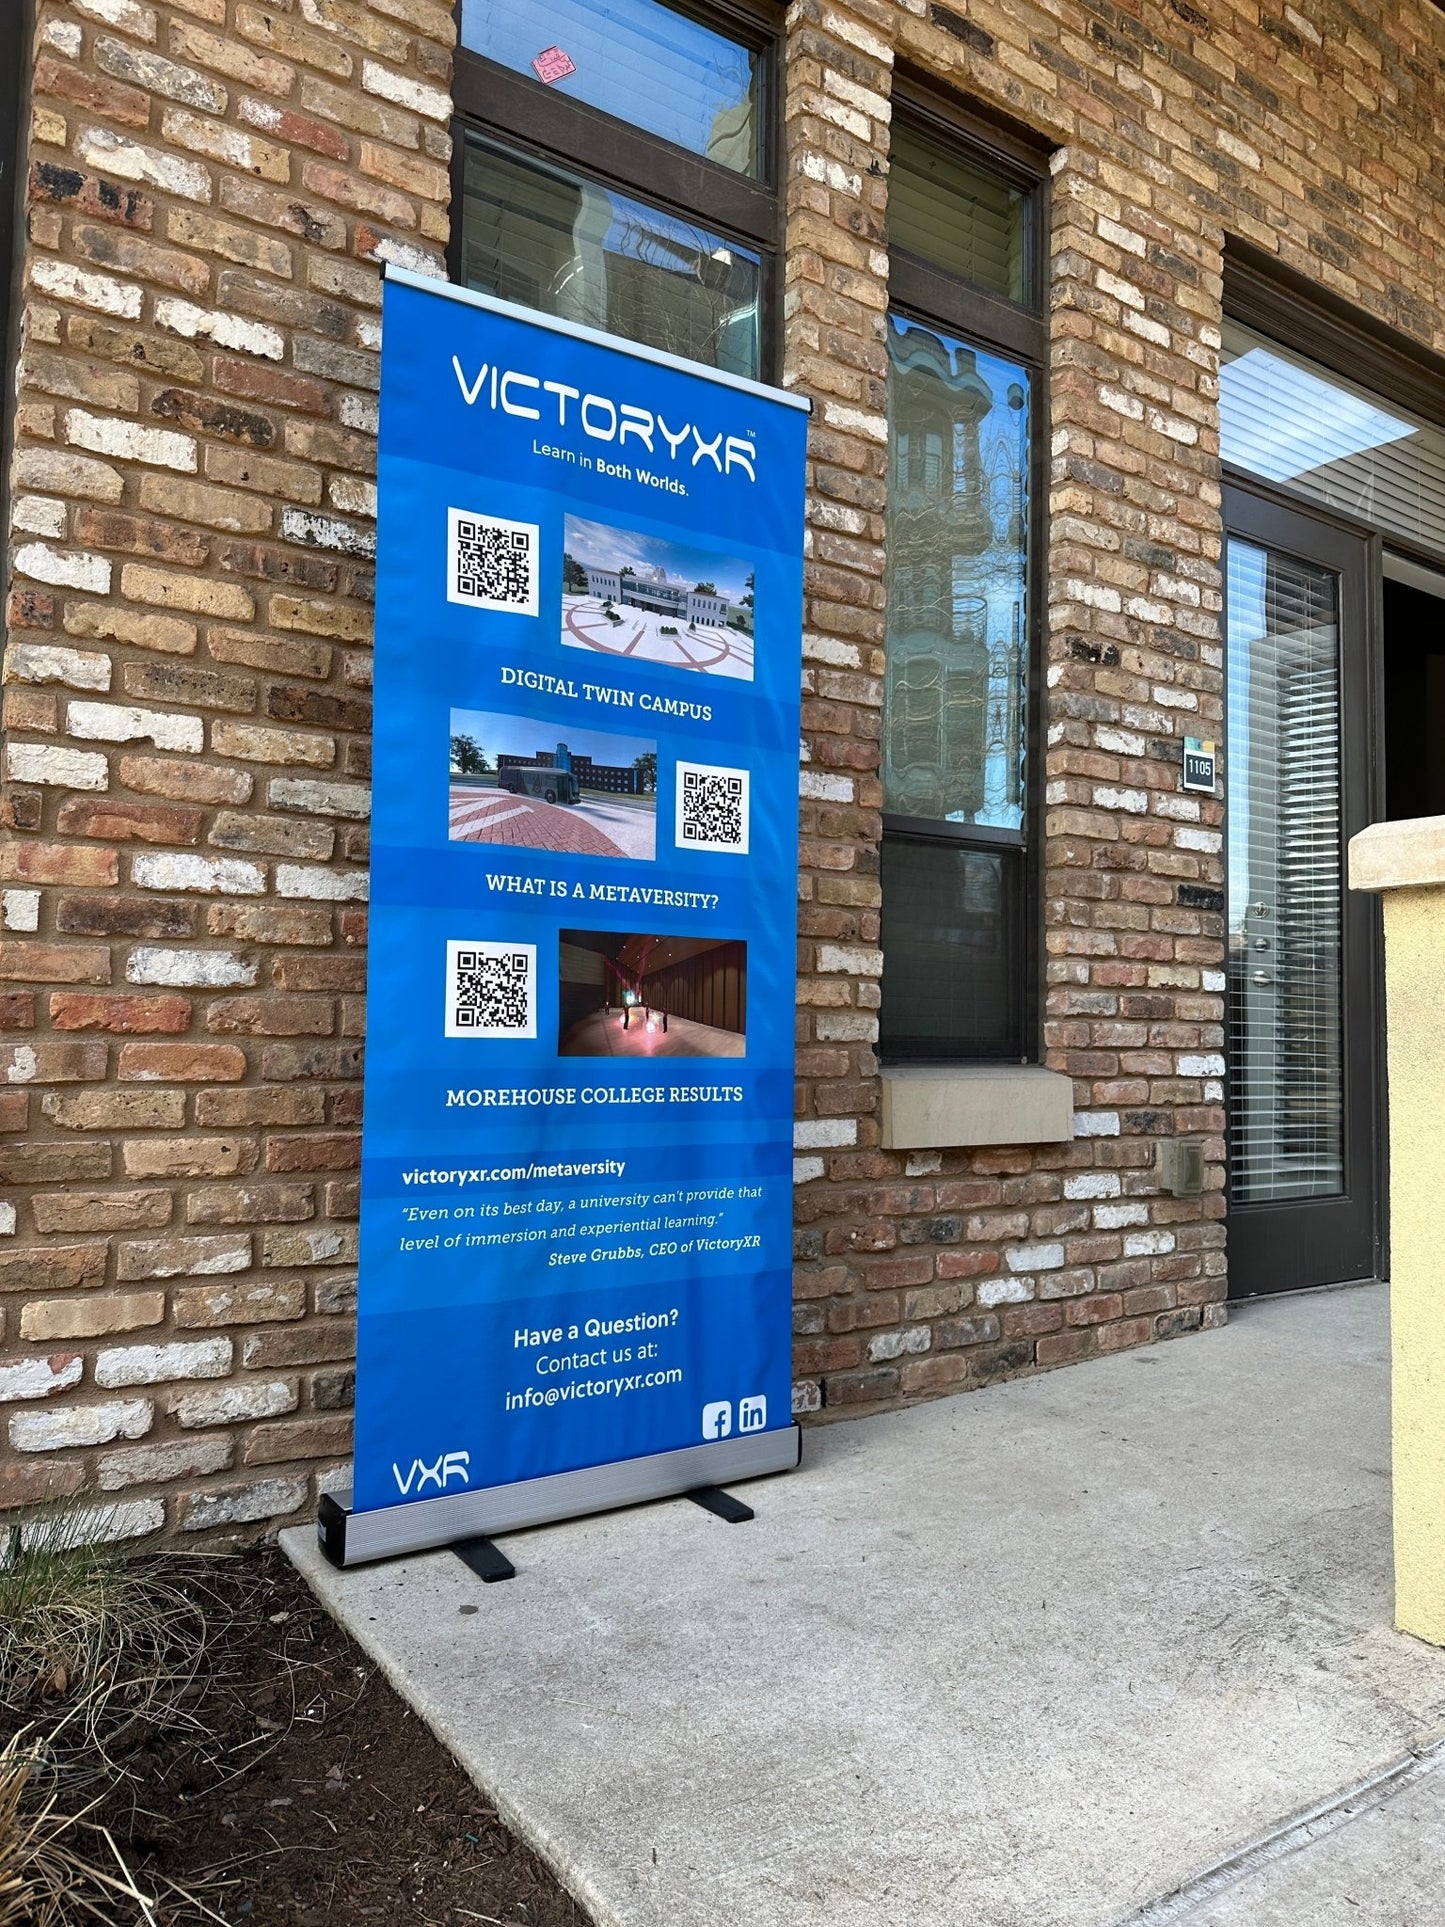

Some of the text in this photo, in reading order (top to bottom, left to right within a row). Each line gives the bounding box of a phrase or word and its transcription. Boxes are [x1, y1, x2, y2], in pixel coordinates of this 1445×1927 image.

[451, 355, 757, 483] VICTORYXR
[532, 439, 689, 497] Learn in Both Worlds.
[500, 666, 712, 722] DIGITAL TWIN CAMPUS
[1188, 759, 1212, 776] 1105
[485, 873, 719, 909] WHAT IS A METAVERSITY?
[445, 1086, 743, 1107] MOREHOUSE COLLEGE RESULTS
[402, 1159, 626, 1187] victoryxr.com/metaversity
[453, 1207, 475, 1218] on
[480, 1204, 499, 1217] its
[503, 1201, 533, 1216] best
[536, 1199, 564, 1214] day,
[568, 1199, 576, 1210] a
[580, 1193, 650, 1209] university
[686, 1187, 735, 1204] provide
[738, 1186, 763, 1199] that
[400, 1235, 440, 1251] level
[443, 1233, 463, 1248] of
[465, 1230, 547, 1246] immersion
[550, 1223, 576, 1239] and
[579, 1217, 661, 1237] experiential
[548, 1235, 761, 1266] Steve Grubbs, CEO of VictoryXR
[514, 1308, 679, 1348] Have a Question?
[536, 1342, 658, 1375] Contact us at:
[505, 1368, 682, 1411] info@victoryxr.com
[392, 1450, 470, 1495] VXR
